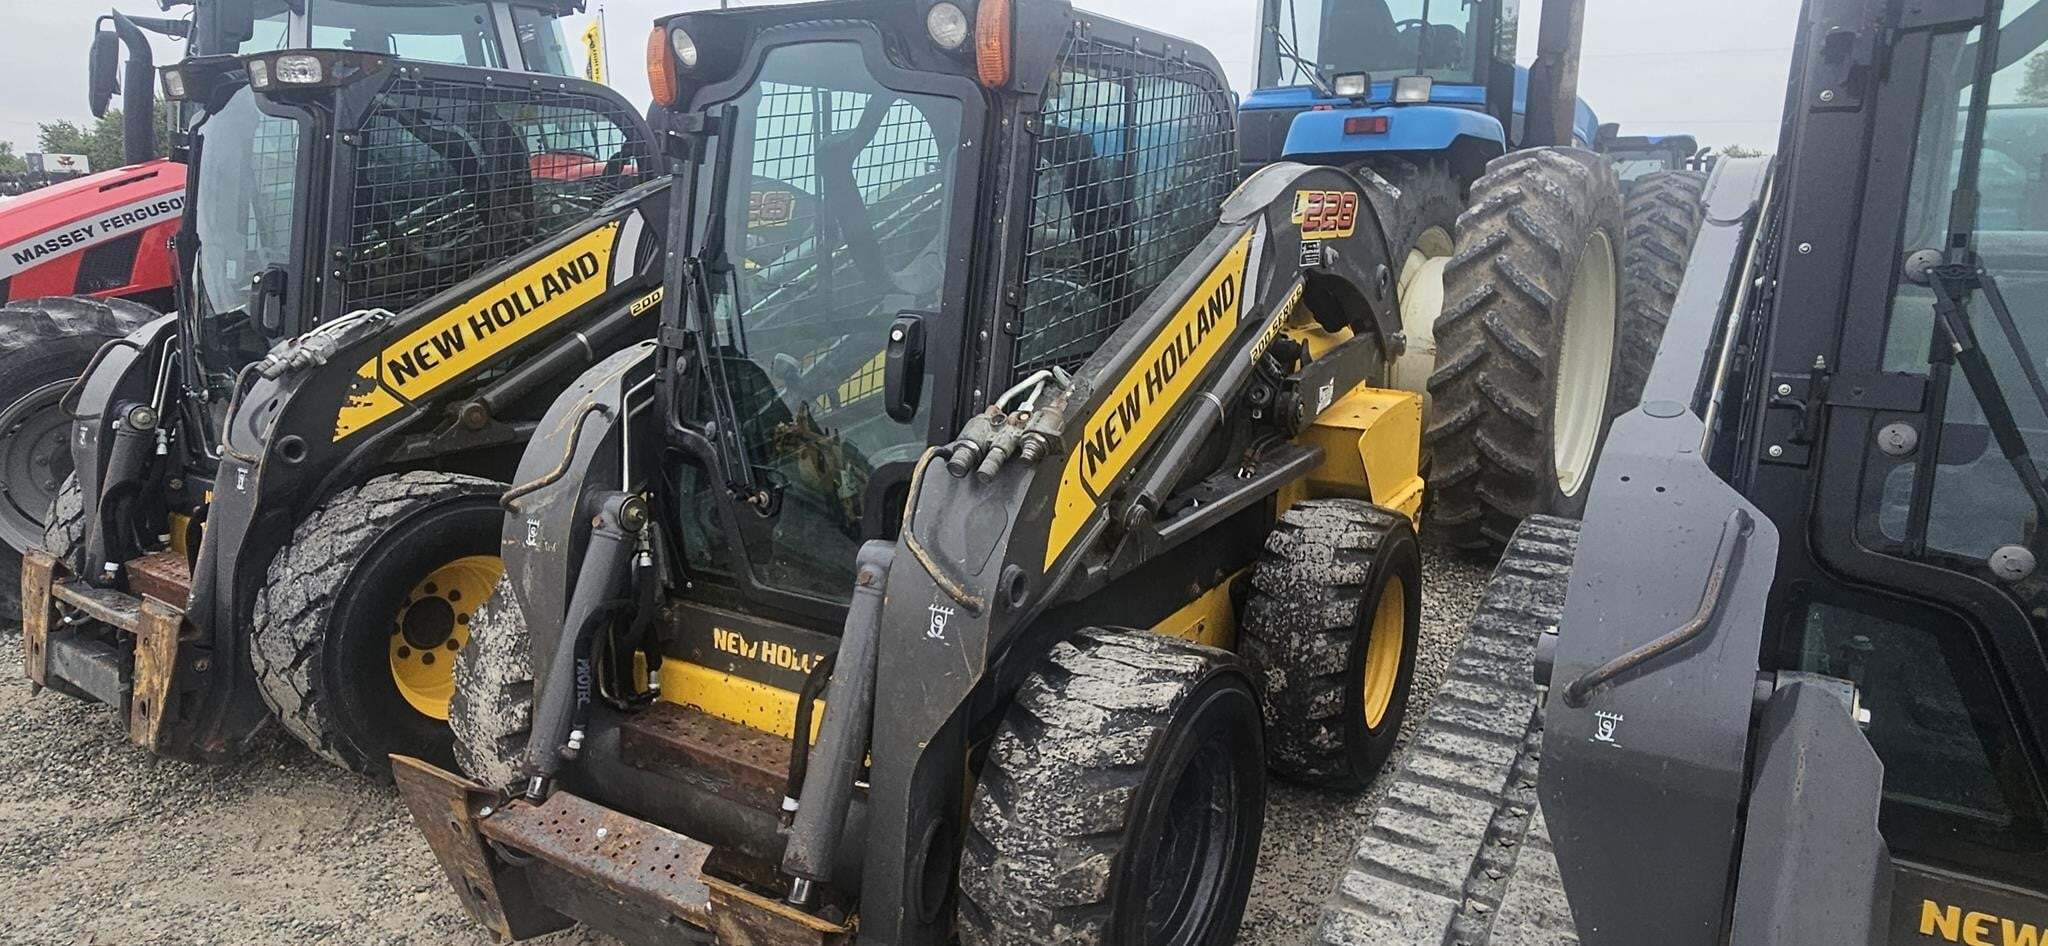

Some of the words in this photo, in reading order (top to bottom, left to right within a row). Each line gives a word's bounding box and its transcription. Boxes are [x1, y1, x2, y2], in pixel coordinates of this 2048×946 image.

[12, 225, 95, 265] MASSEY
[100, 196, 185, 233] FERGUSO
[387, 324, 466, 386] NEW
[467, 251, 599, 341] HOLLAND
[632, 291, 661, 314] 200
[1085, 383, 1141, 477] NEW
[1145, 273, 1235, 406] HOLLAND
[713, 627, 759, 659] NEW
